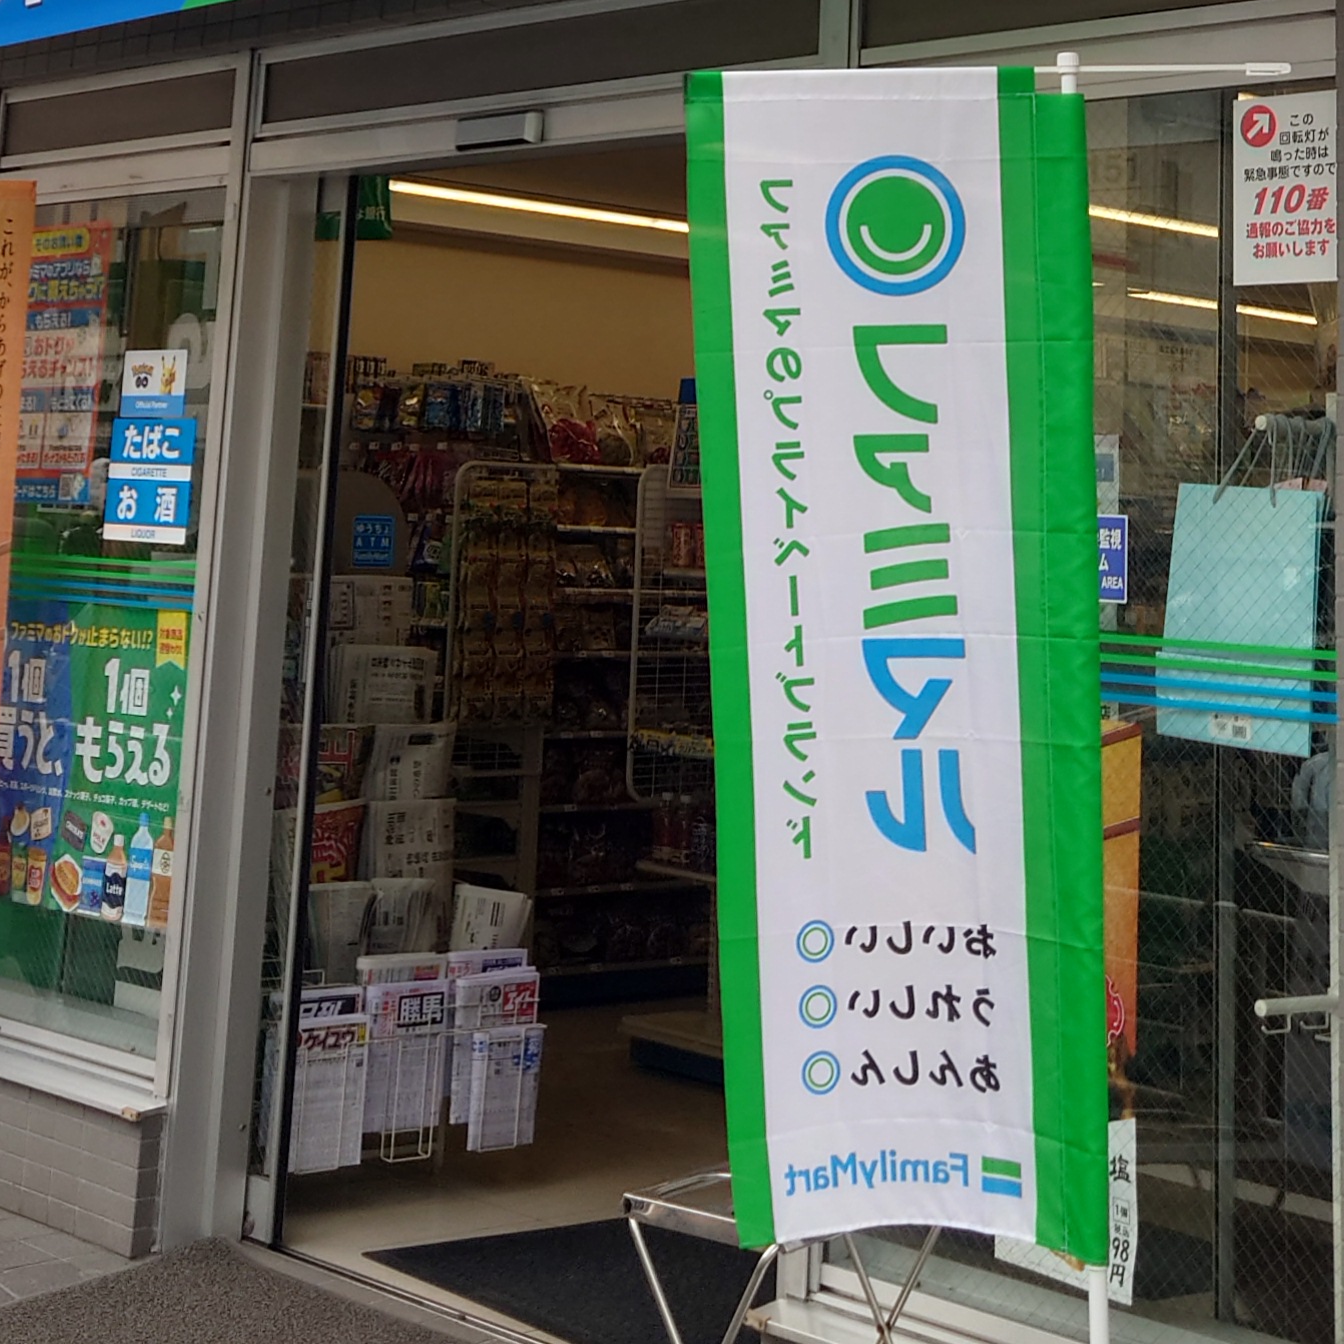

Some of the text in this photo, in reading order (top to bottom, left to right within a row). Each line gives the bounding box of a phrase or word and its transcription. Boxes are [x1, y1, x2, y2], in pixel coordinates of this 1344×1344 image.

[1290, 113, 1314, 126] この
[1280, 129, 1329, 145] 回転灯が
[1271, 146, 1329, 163] 鳴った時は
[1244, 162, 1336, 182] 緊急事態ですので
[1254, 184, 1329, 215] 110番
[1246, 218, 1336, 239] 通報のご協力を
[1252, 239, 1330, 259] お願いします
[122, 424, 180, 460] たばこ
[131, 467, 167, 478] CIGARETTE
[131, 529, 156, 539] LIQUOR
[1097, 528, 1122, 550] 監視
[1101, 576, 1124, 589] AREA
[8, 650, 47, 704] 1個
[103, 658, 150, 717] 1個
[75, 716, 173, 787] もらえる
[106, 882, 123, 896] Latte
[1109, 1154, 1131, 1183] 塩
